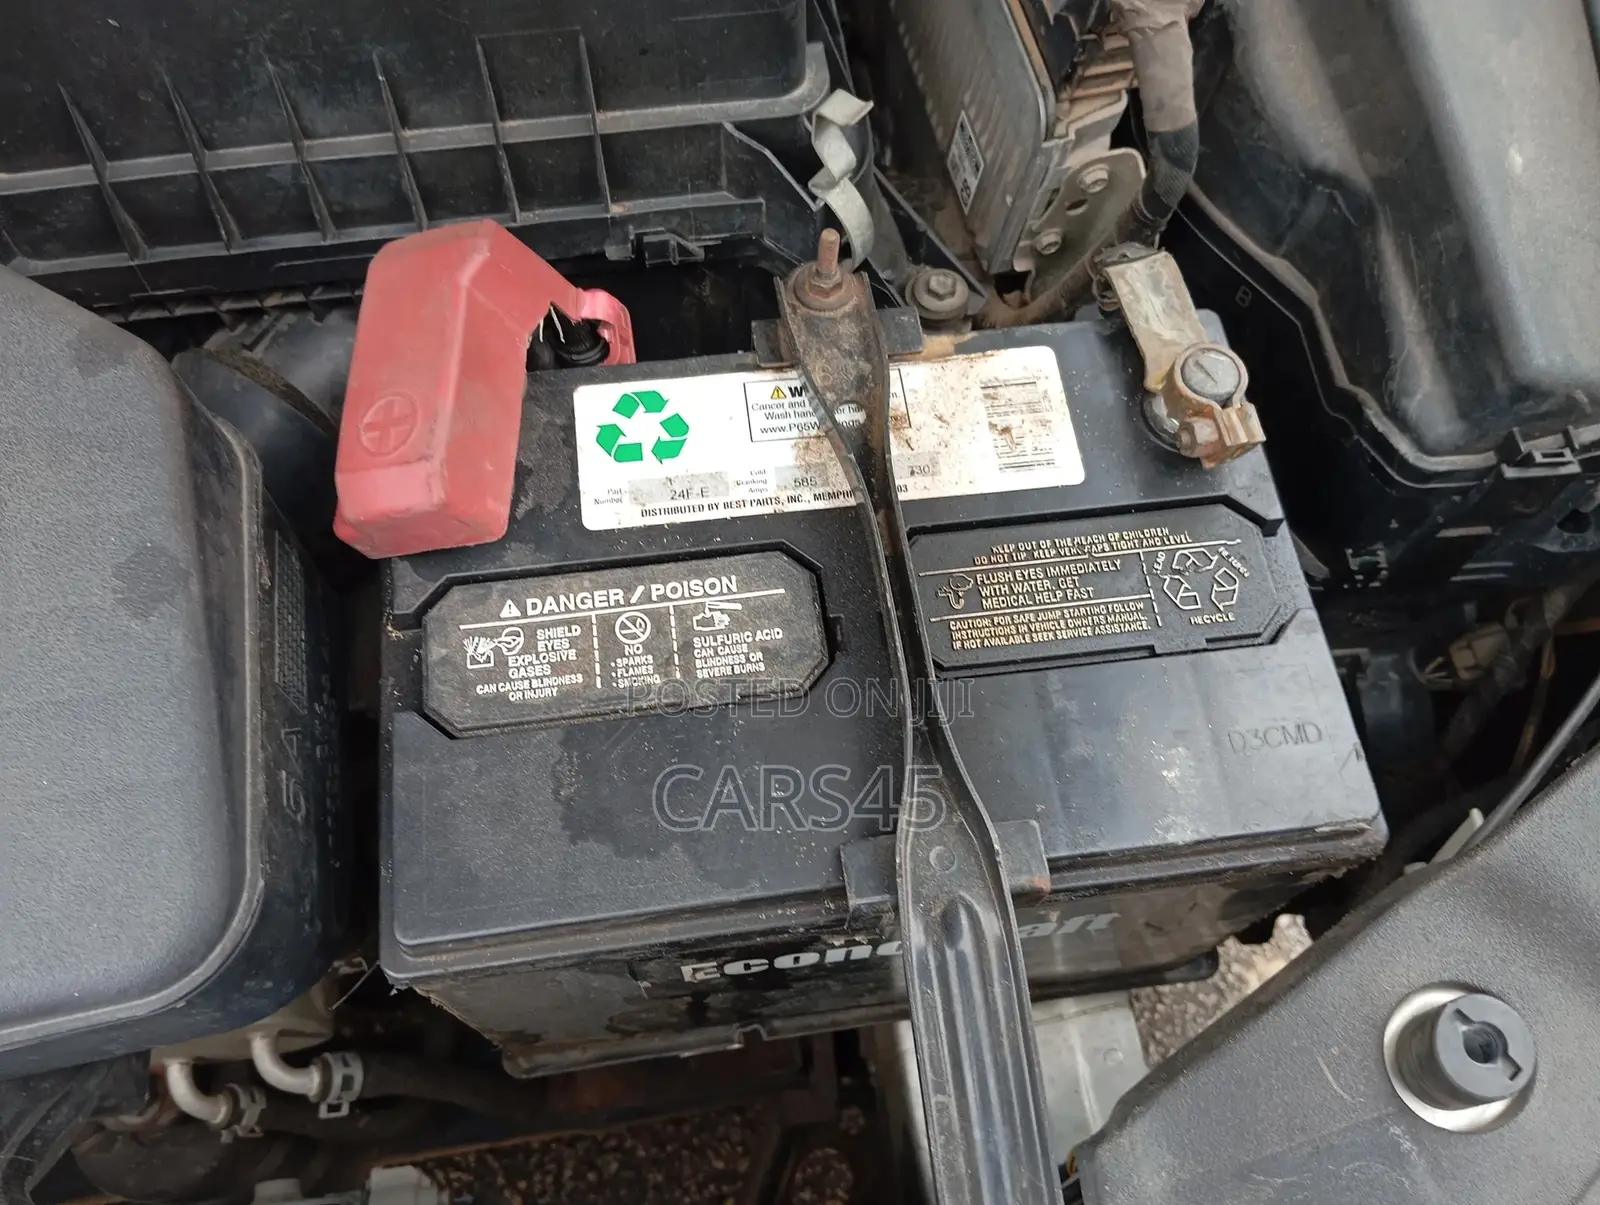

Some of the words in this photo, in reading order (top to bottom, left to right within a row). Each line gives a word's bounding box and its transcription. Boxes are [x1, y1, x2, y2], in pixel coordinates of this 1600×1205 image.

[788, 400, 806, 408] and
[764, 411, 792, 420] Wash
[640, 503, 705, 518] DISTRIBUTED
[707, 502, 720, 511] BY
[723, 499, 747, 510] BEST
[1018, 541, 1037, 551] OUT
[1040, 539, 1051, 549] OF
[1054, 537, 1073, 548] THE
[1107, 531, 1120, 541] OF
[1122, 527, 1169, 541] CHILDREN
[974, 555, 988, 566] DO
[989, 553, 1009, 564] NOT
[1112, 539, 1139, 551] TIGHT
[1142, 537, 1160, 547] AND
[1163, 533, 1192, 544] LEVEL
[976, 571, 1013, 586] FLUSH
[1016, 567, 1044, 581] EYES
[1046, 558, 1121, 578] IMMEDIATELY
[978, 583, 1010, 597] WITH
[1059, 575, 1080, 590] GET
[526, 588, 625, 616] DANGER
[650, 575, 738, 601] POISON
[981, 594, 1033, 610] MEDICAL
[1035, 590, 1064, 606] HELP
[1066, 586, 1094, 602] FAST
[949, 618, 992, 631] CAUTION:
[994, 616, 1012, 627] FOR
[1013, 613, 1036, 625] SAFE
[1036, 611, 1061, 622] JUMP
[1063, 605, 1107, 619] STARTING
[1107, 601, 1145, 614] FOLLOW
[1190, 612, 1236, 625] RECYCLE
[536, 624, 581, 640] SHIELD
[693, 631, 753, 648] SULFURIC
[755, 628, 783, 642] ACID
[951, 625, 1016, 641] INSTRUCTIONS
[1017, 624, 1028, 634] IN
[1029, 619, 1064, 632] VEHICLE
[952, 641, 963, 650] IF
[963, 639, 982, 650] NOT
[983, 633, 1031, 647] AVAILABLE
[1032, 631, 1055, 642] SEEK
[1056, 626, 1093, 640] SERVICE
[1094, 620, 1151, 636] ASSISTANCE.
[537, 638, 570, 652] EYES
[624, 643, 643, 656] NO
[693, 647, 714, 659] CAN
[717, 643, 748, 656] CAUSE
[508, 649, 577, 667] EXPLOSIVE
[616, 655, 654, 667] SPARKS
[694, 654, 746, 668] BLINDNESS
[749, 651, 764, 662] OR
[508, 664, 551, 679] GASES
[617, 665, 654, 678] FLAMES
[695, 665, 732, 679] SEVERE
[734, 662, 765, 674] BURNS
[476, 683, 496, 694] CAN
[498, 680, 530, 692] CAUSE
[531, 673, 583, 689] BLINDNESS
[618, 674, 661, 688] SMOKING
[508, 691, 523, 702] OR
[524, 687, 558, 700] INJURY
